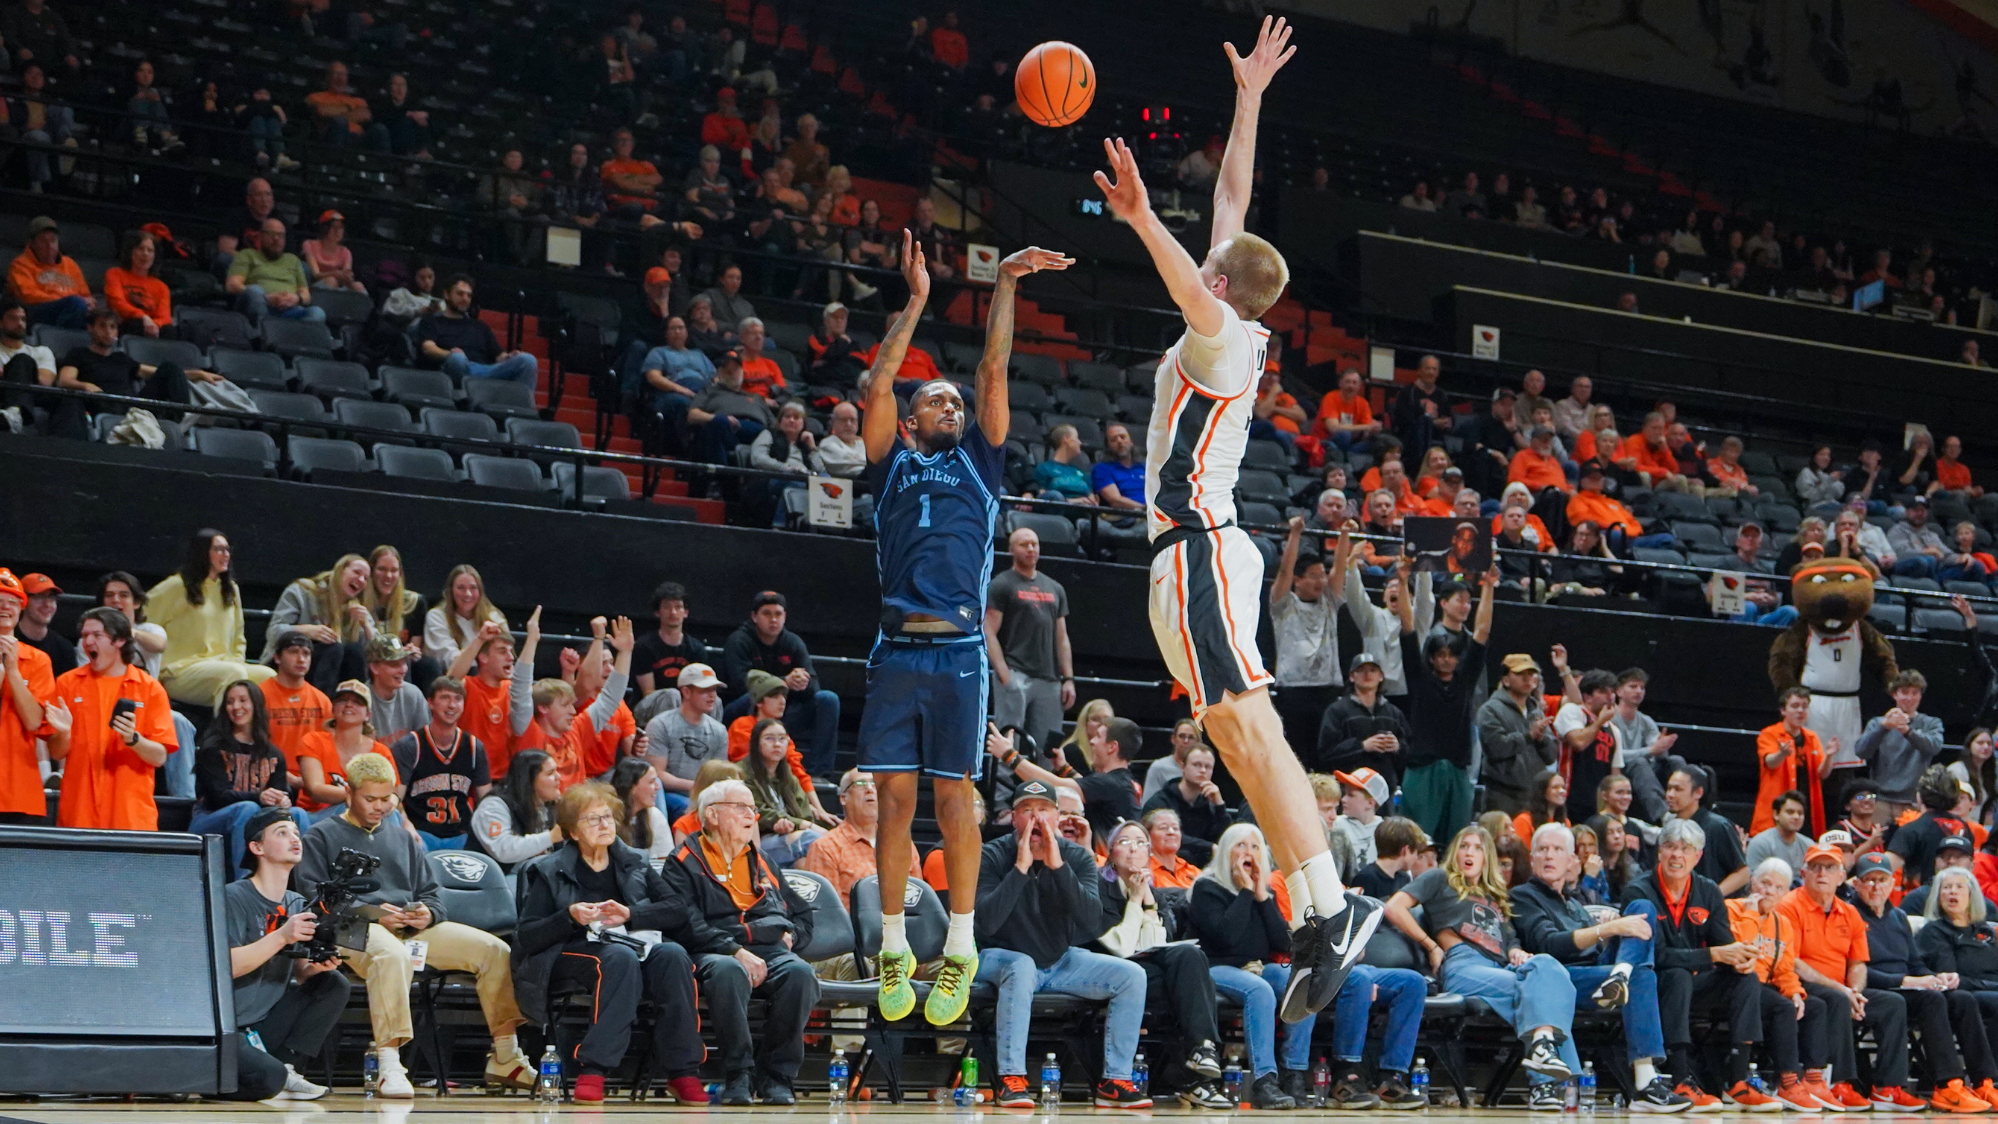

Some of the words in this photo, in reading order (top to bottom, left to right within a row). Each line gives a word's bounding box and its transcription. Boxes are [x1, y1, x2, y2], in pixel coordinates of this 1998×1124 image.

[896, 473, 919, 493] SAN
[921, 467, 961, 487] DIEGO
[918, 493, 931, 527] 1
[426, 796, 461, 824] 31
